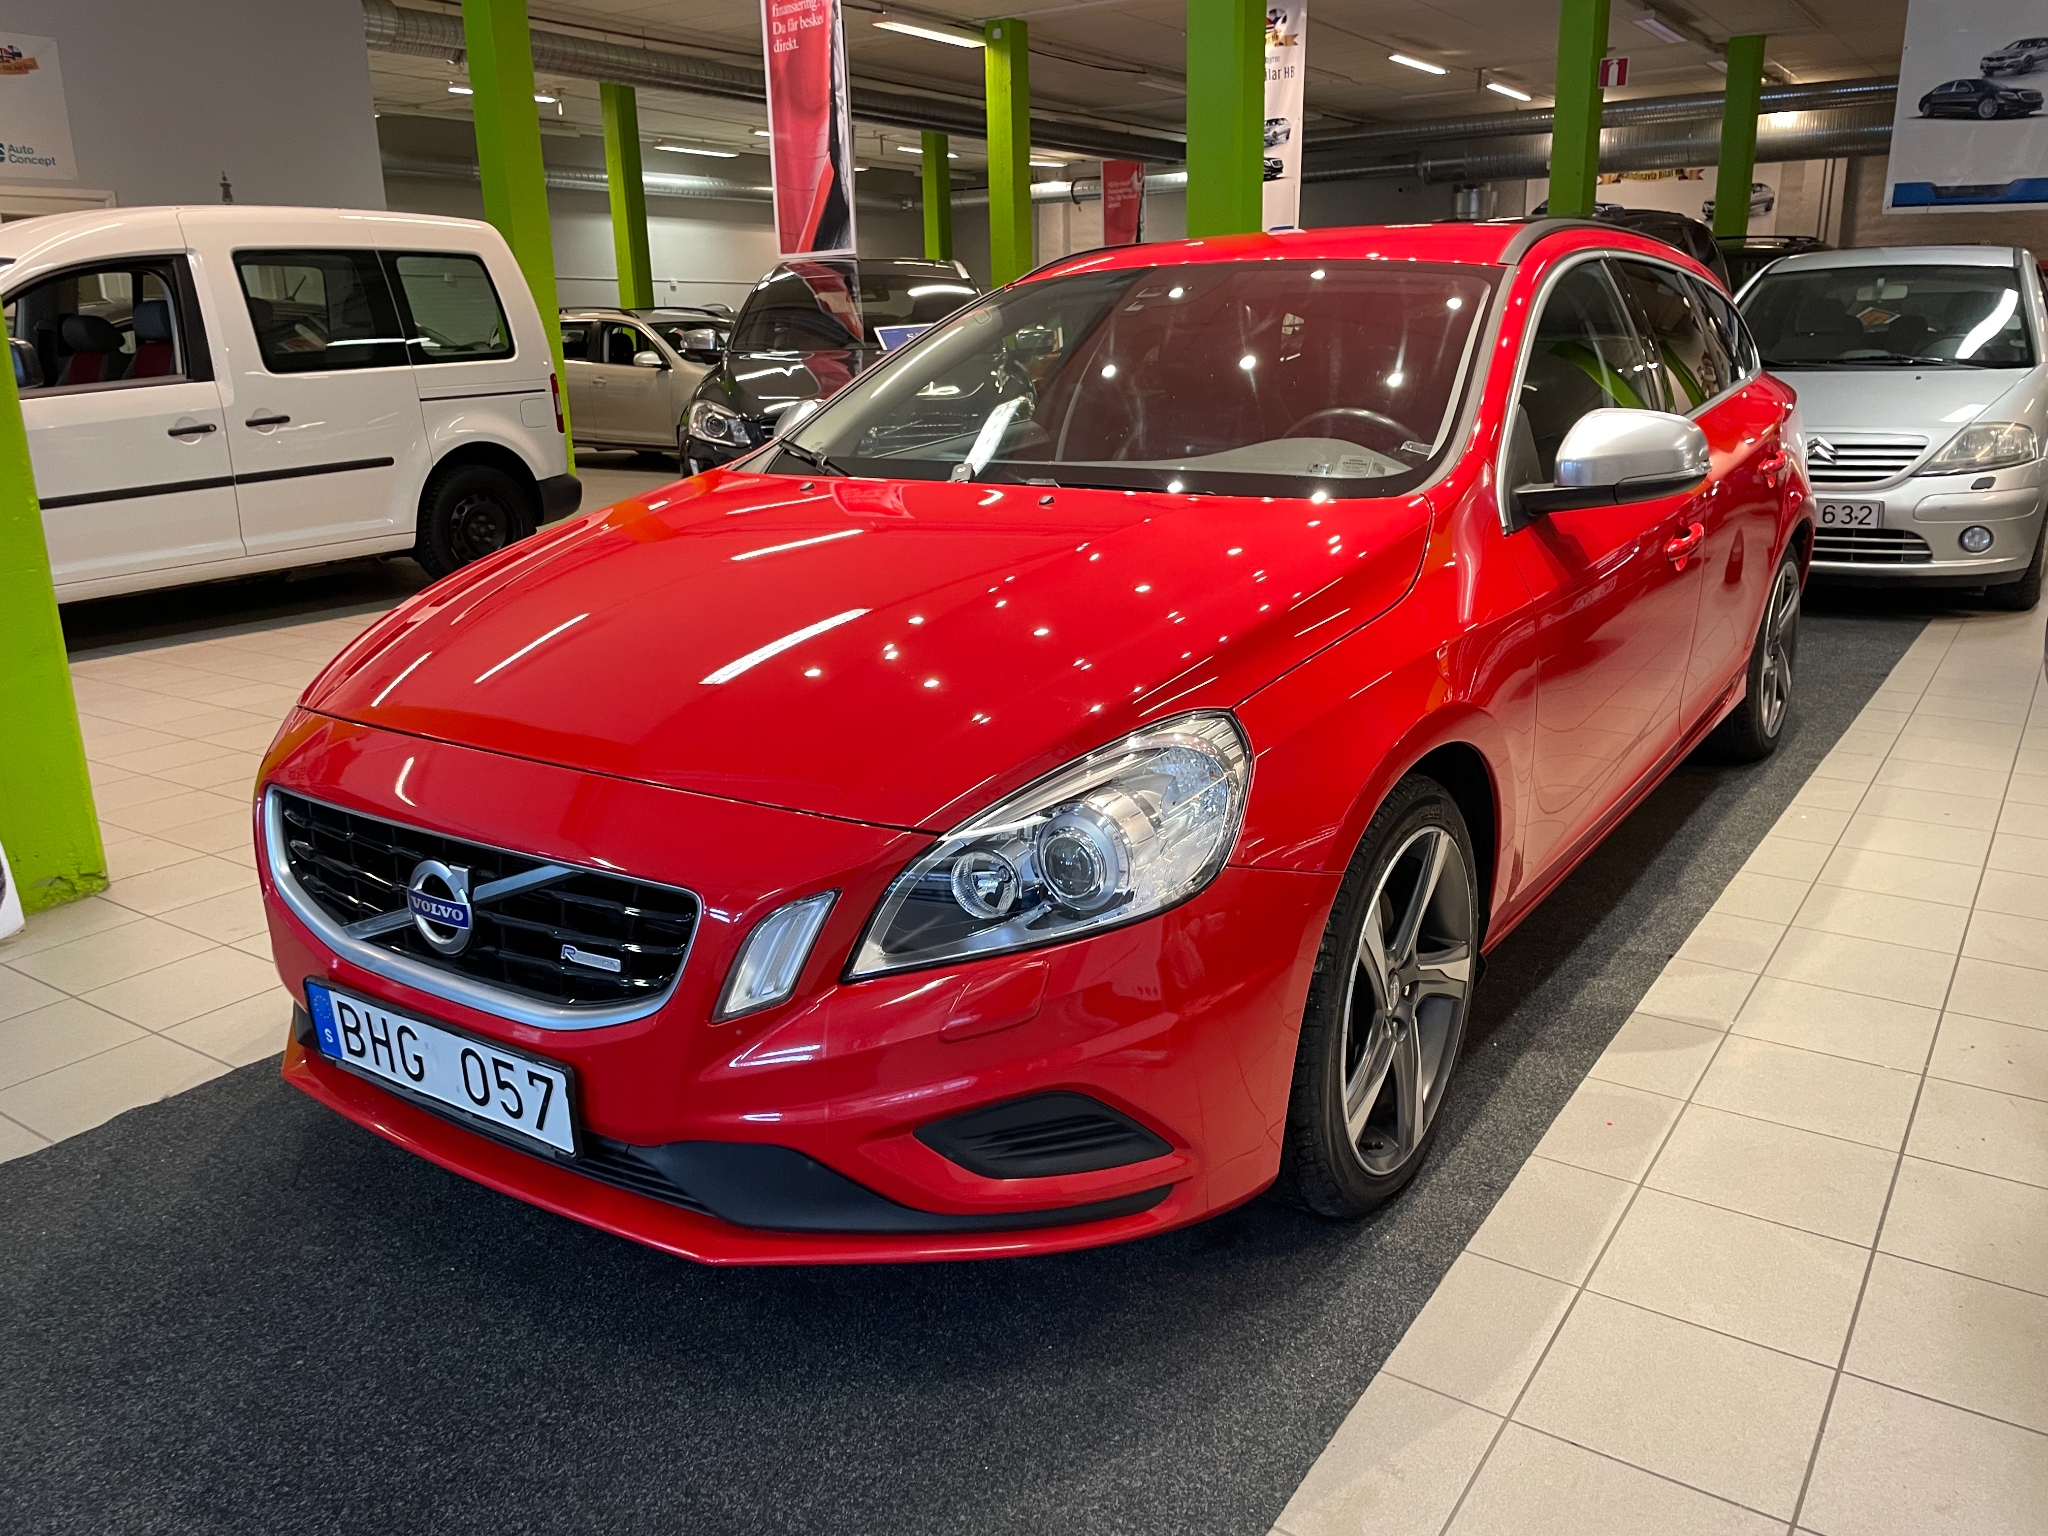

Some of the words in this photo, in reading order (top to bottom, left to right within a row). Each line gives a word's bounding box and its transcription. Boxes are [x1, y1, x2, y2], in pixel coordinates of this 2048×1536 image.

[773, 21, 787, 35] Du
[787, 17, 799, 32] får
[773, 38, 799, 53] direkt.
[1284, 66, 1295, 79] HB
[8, 144, 34, 154] Auto
[9, 153, 56, 167] Concept
[410, 895, 464, 922] VOLVO
[324, 1028, 334, 1044] S
[336, 1000, 426, 1082] BHG
[461, 1047, 554, 1131] 057
